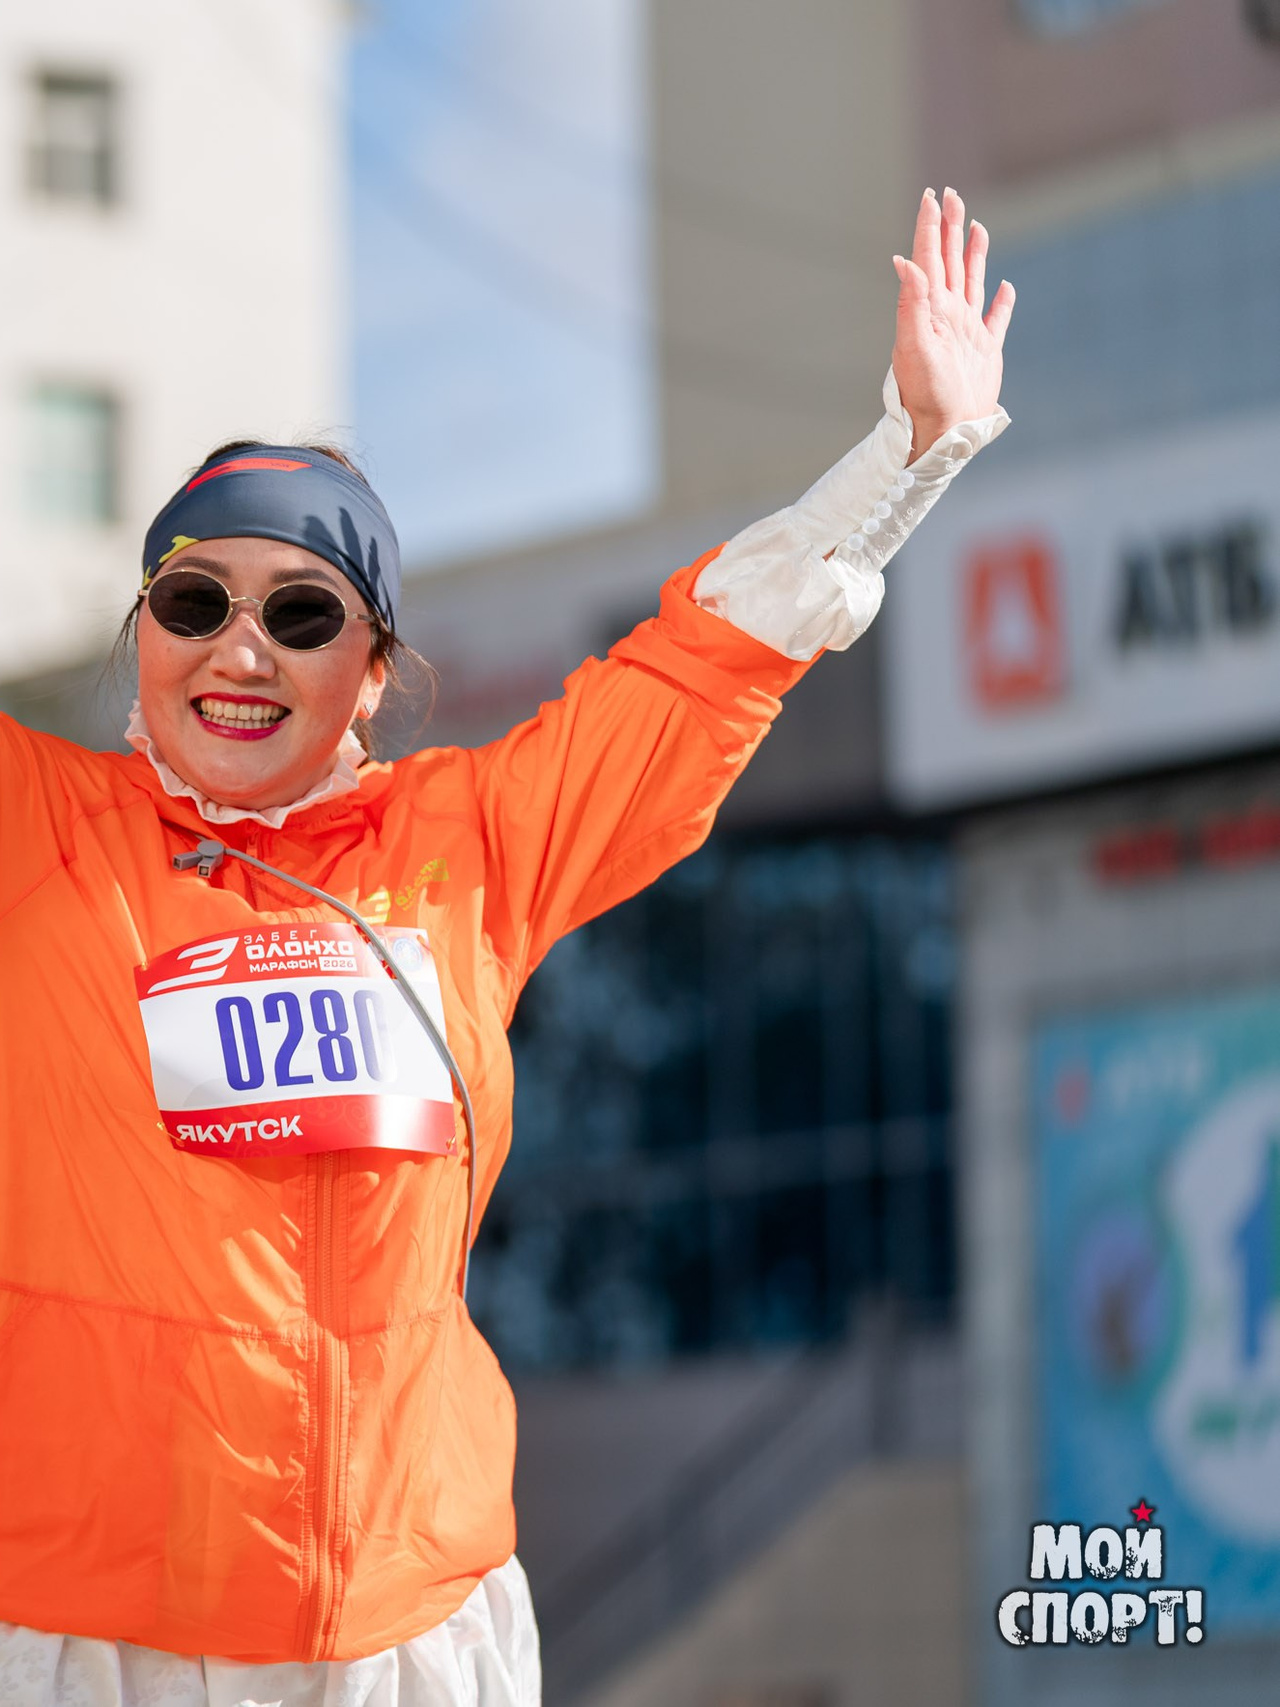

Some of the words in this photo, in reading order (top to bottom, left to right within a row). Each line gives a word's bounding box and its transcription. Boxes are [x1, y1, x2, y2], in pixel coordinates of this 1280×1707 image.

[244, 930, 317, 944] ЗАБЕГ
[245, 940, 354, 960] ОЛОНХО
[249, 959, 318, 973] МАРАФОН
[323, 959, 353, 968] 2026
[176, 1115, 303, 1143] ЯКУТСК
